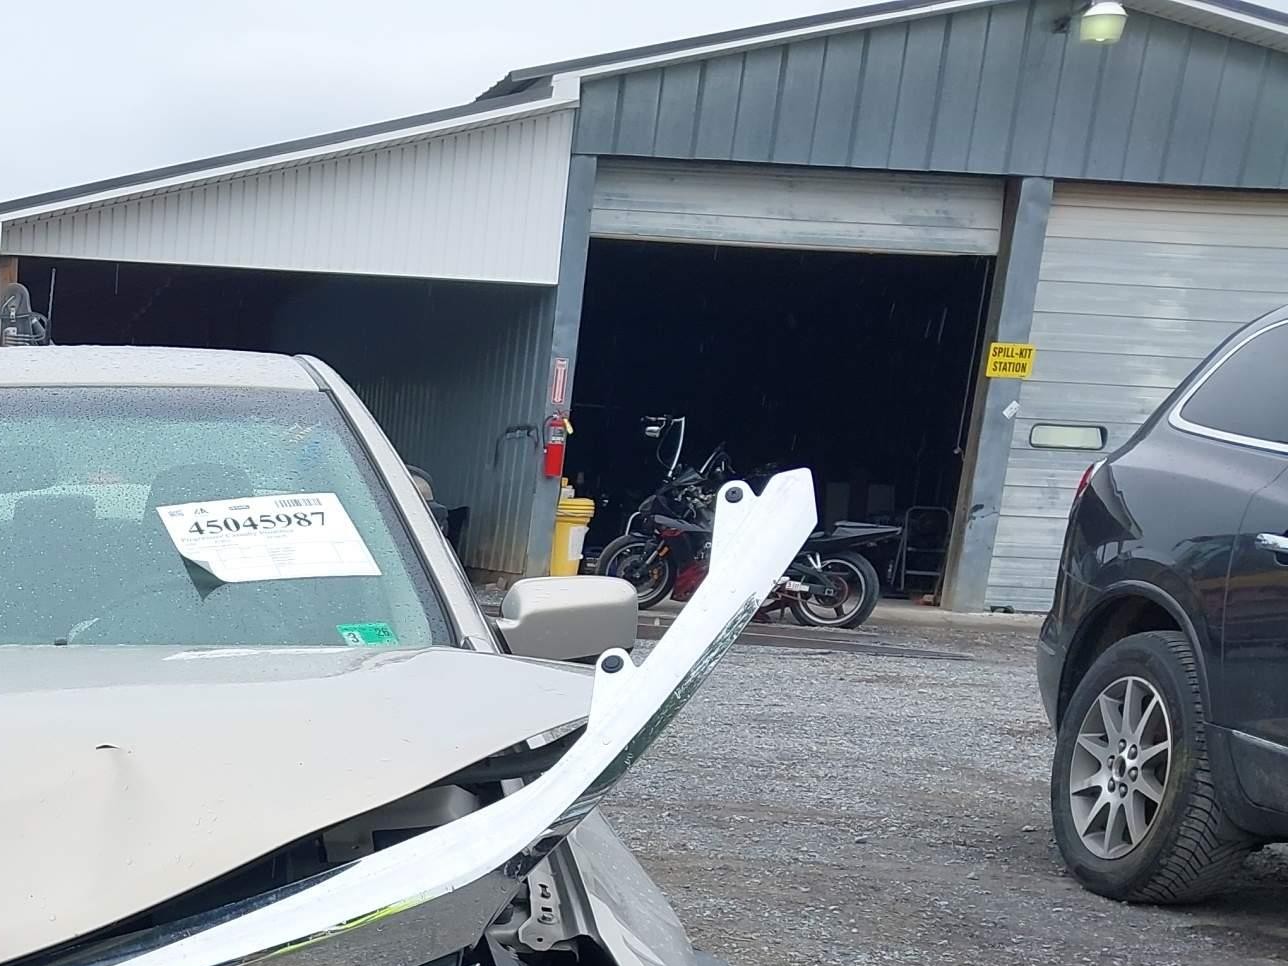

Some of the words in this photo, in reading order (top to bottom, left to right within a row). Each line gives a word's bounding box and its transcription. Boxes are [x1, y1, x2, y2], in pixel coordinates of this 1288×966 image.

[992, 346, 1033, 359] SPILL-KIT
[992, 361, 1027, 373] STATION
[188, 511, 325, 535] 45045987
[347, 632, 360, 643] 3
